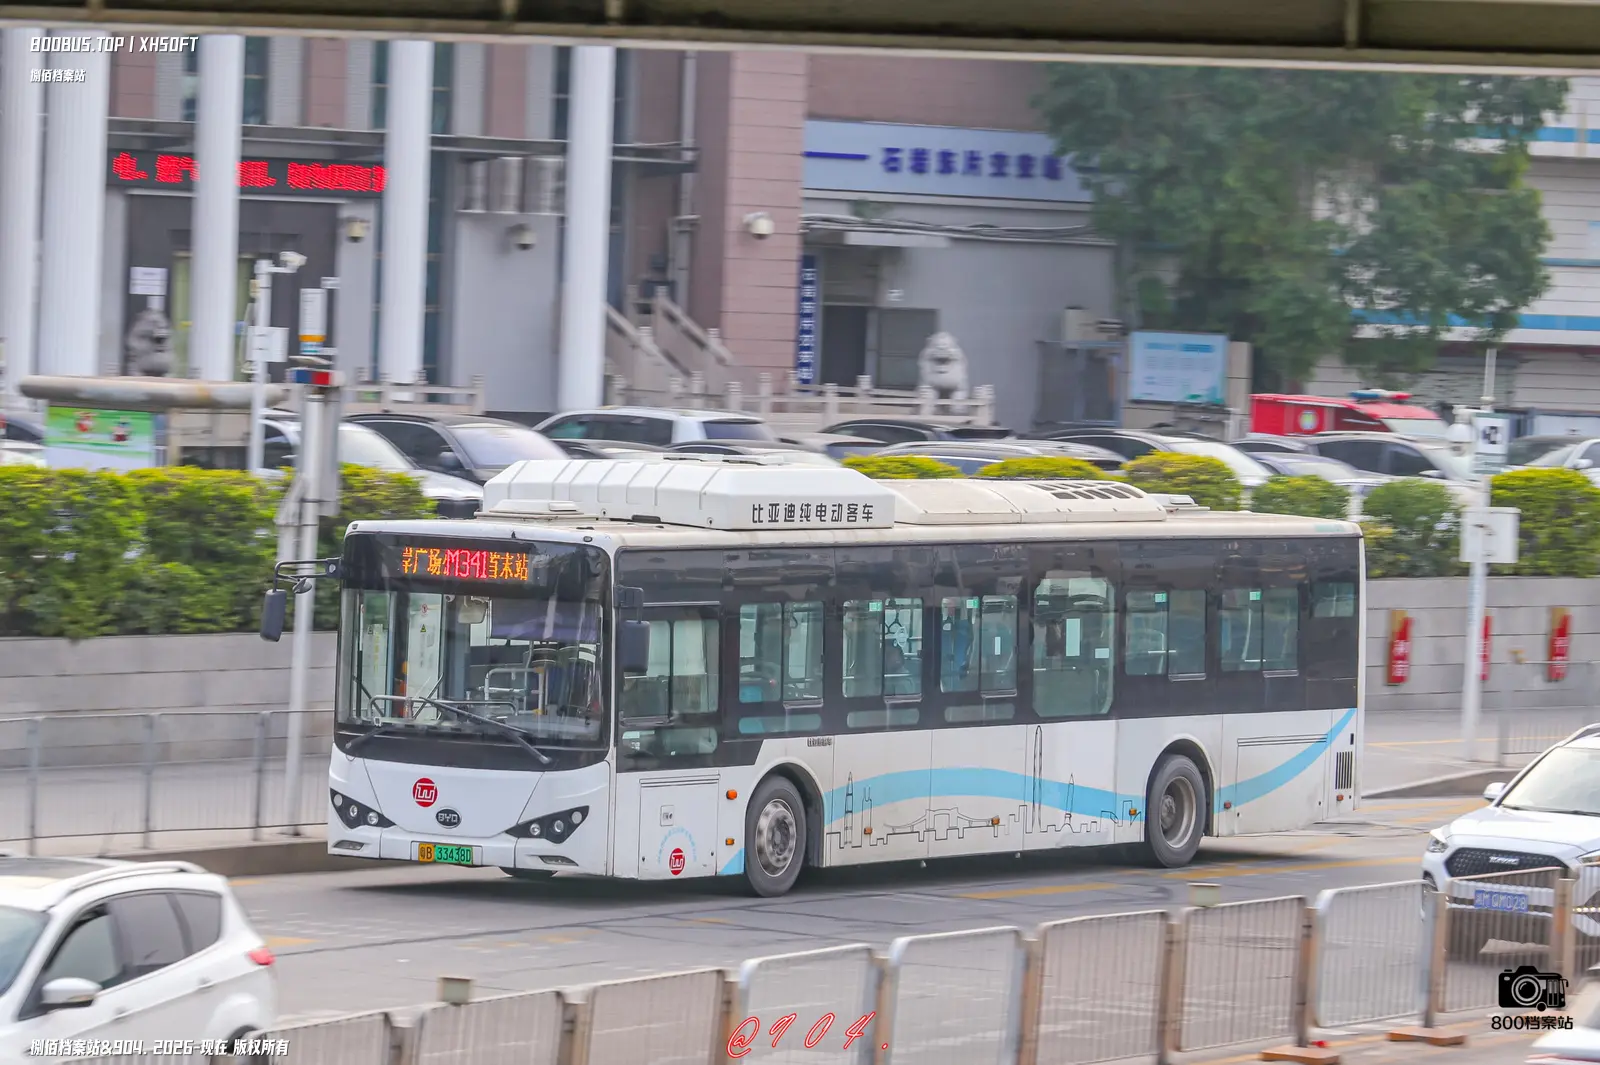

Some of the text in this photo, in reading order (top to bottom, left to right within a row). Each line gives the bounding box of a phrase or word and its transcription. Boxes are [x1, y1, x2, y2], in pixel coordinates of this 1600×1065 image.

[752, 502, 874, 523] 比亚迪纯电动客车
[445, 548, 489, 579] M341
[438, 812, 458, 823] BYD
